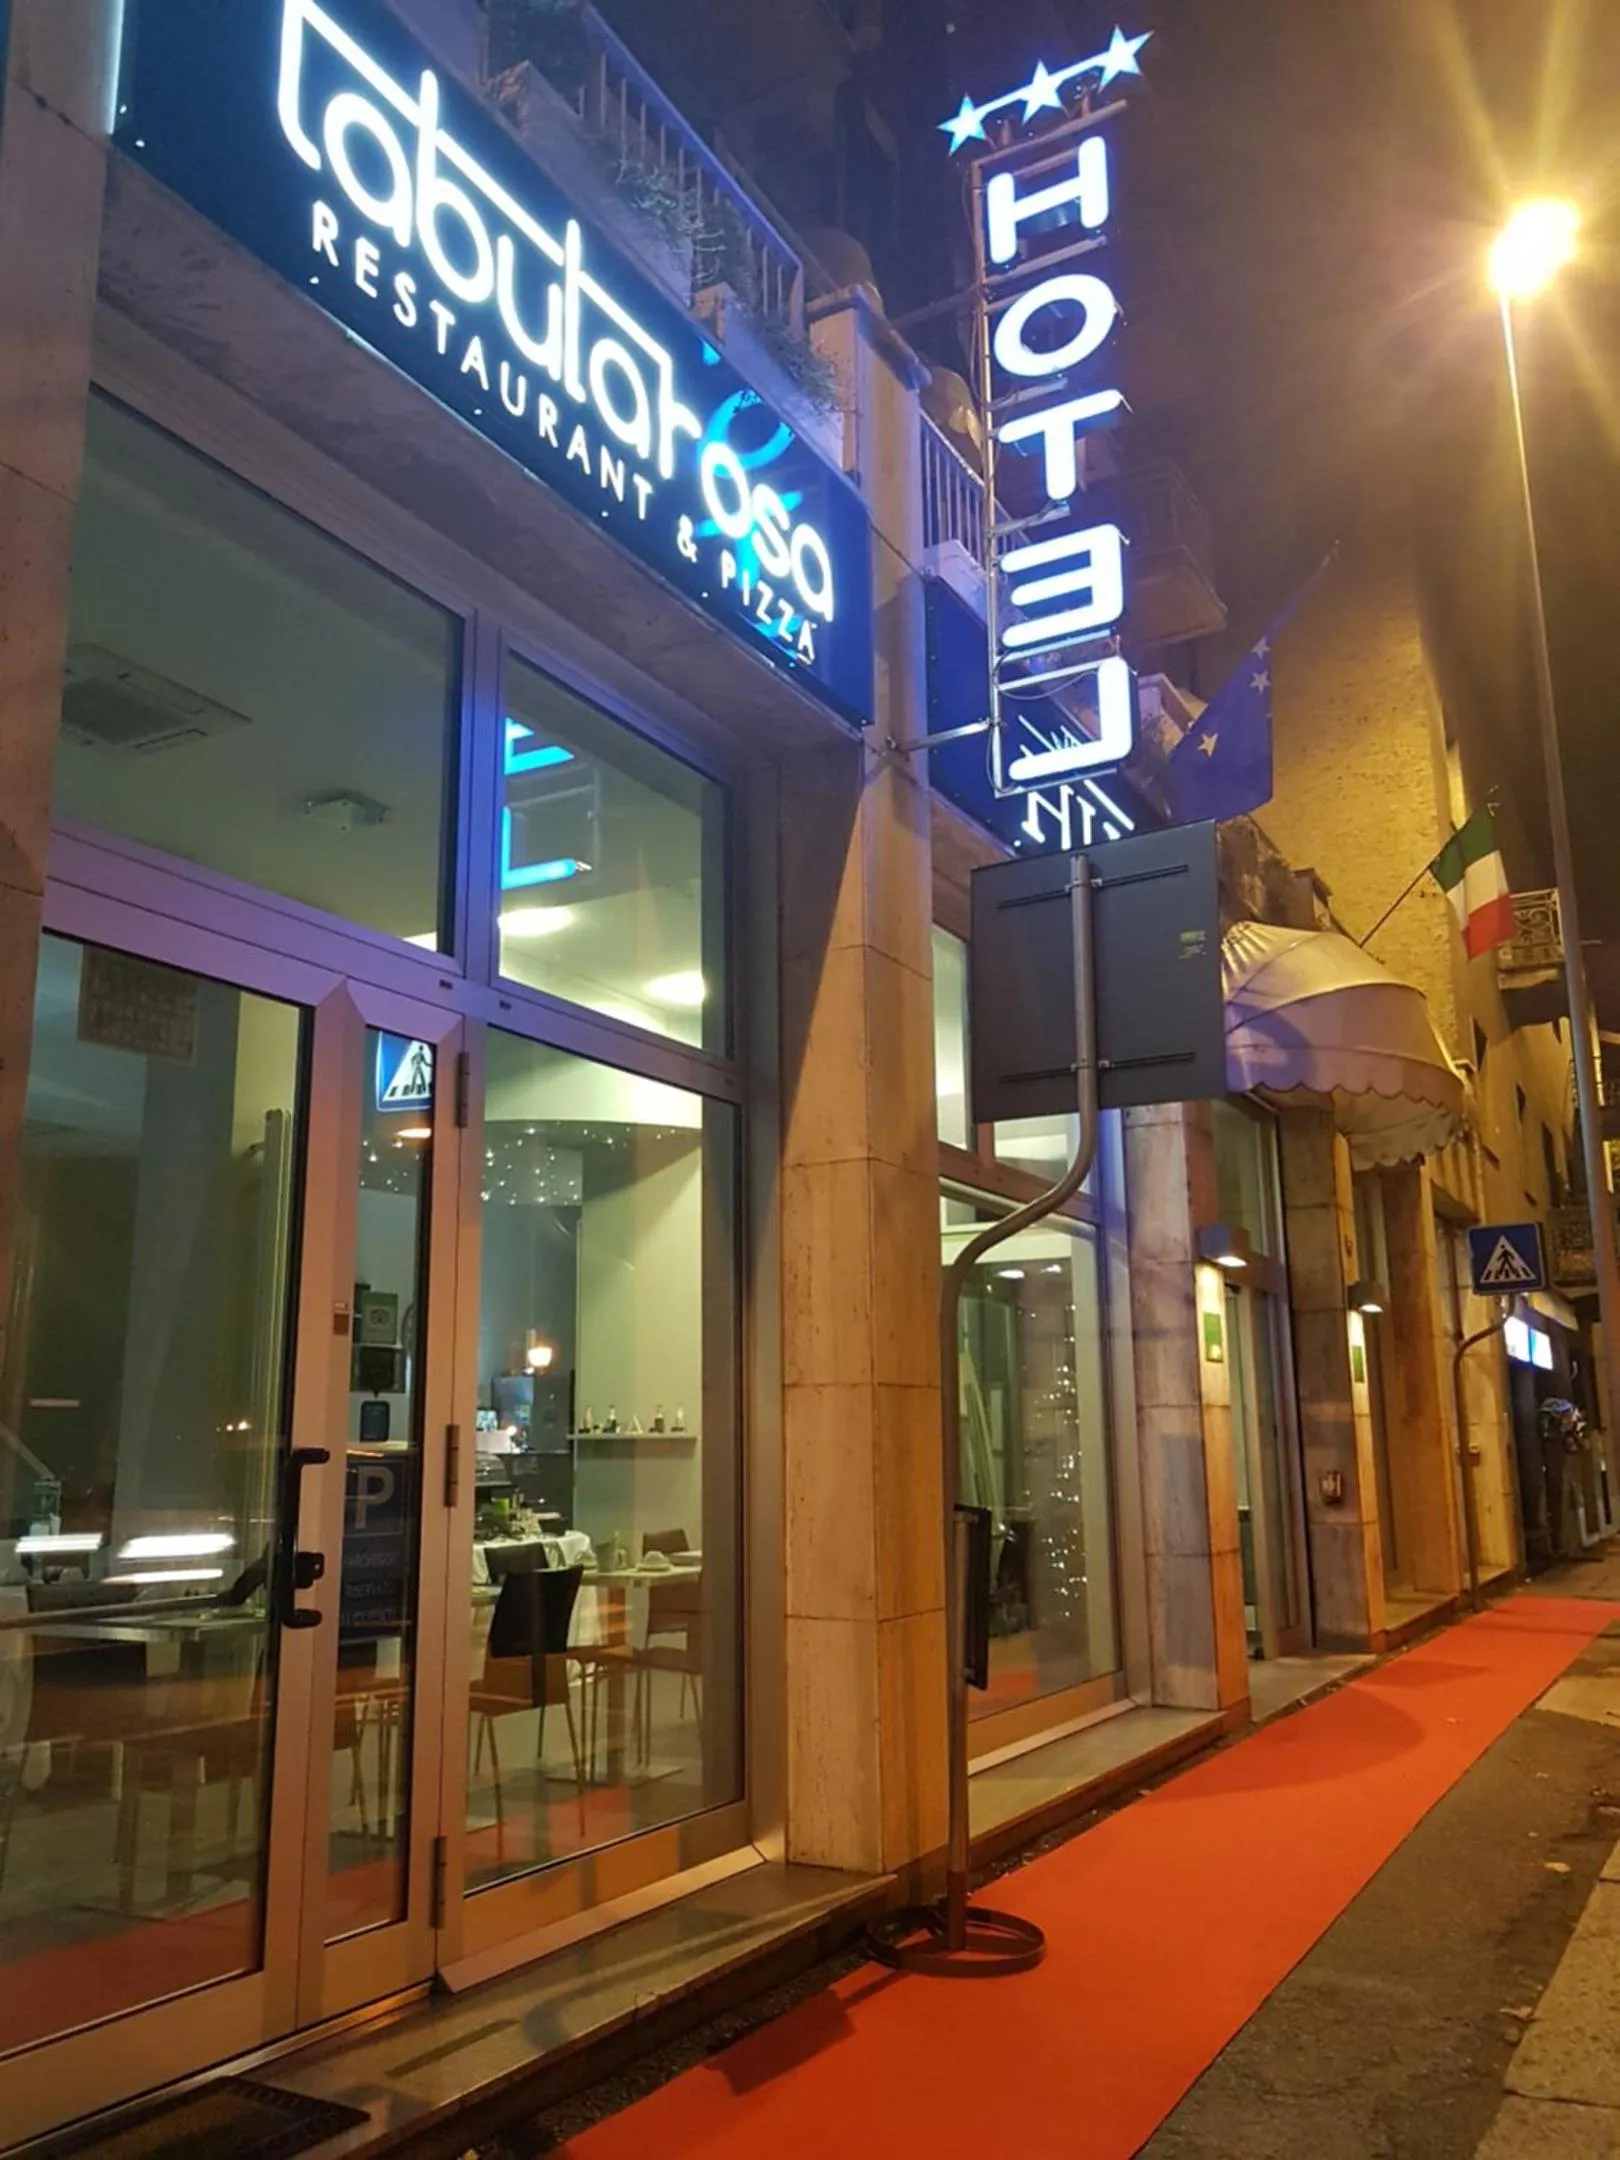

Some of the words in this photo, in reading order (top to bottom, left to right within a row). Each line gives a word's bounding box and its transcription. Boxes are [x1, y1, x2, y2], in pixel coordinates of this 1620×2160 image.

[311, 200, 655, 521] RESTAURANT
[676, 514, 699, 563] &
[720, 548, 815, 664] PIZZA
[355, 1465, 396, 1530] P
